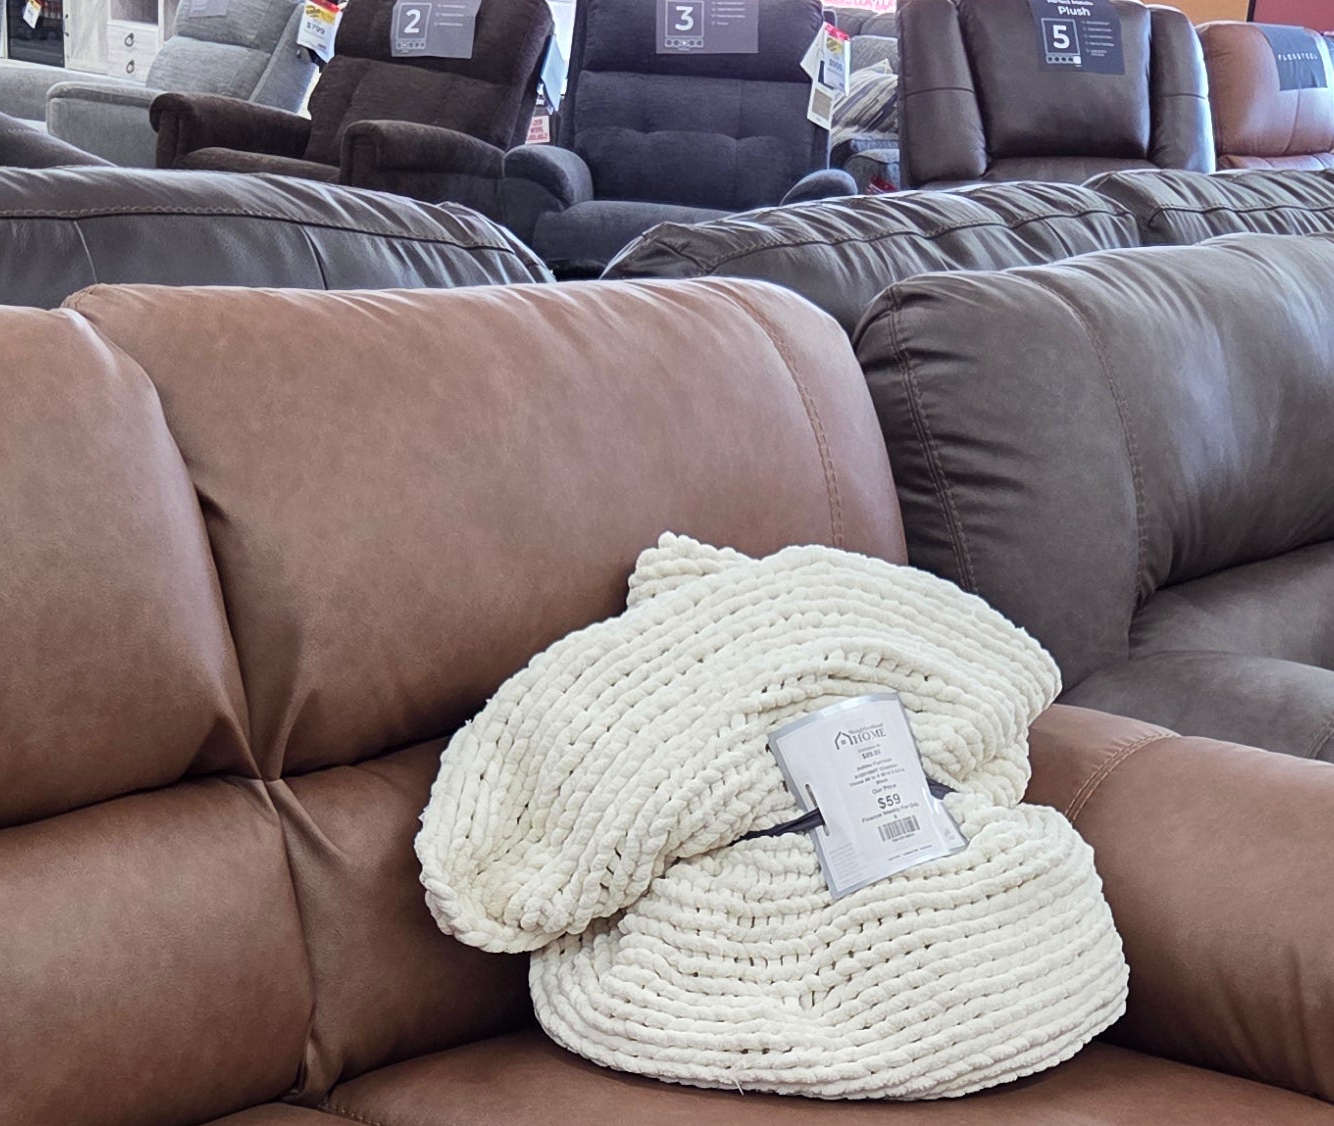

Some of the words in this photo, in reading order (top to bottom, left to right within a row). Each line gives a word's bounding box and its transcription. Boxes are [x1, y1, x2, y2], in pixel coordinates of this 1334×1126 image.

[403, 9, 422, 34] 2
[675, 5, 694, 31] 3
[1058, 6, 1091, 16] Plush
[1053, 24, 1070, 49] 5
[851, 728, 887, 746] HOME
[877, 793, 901, 810] $59
